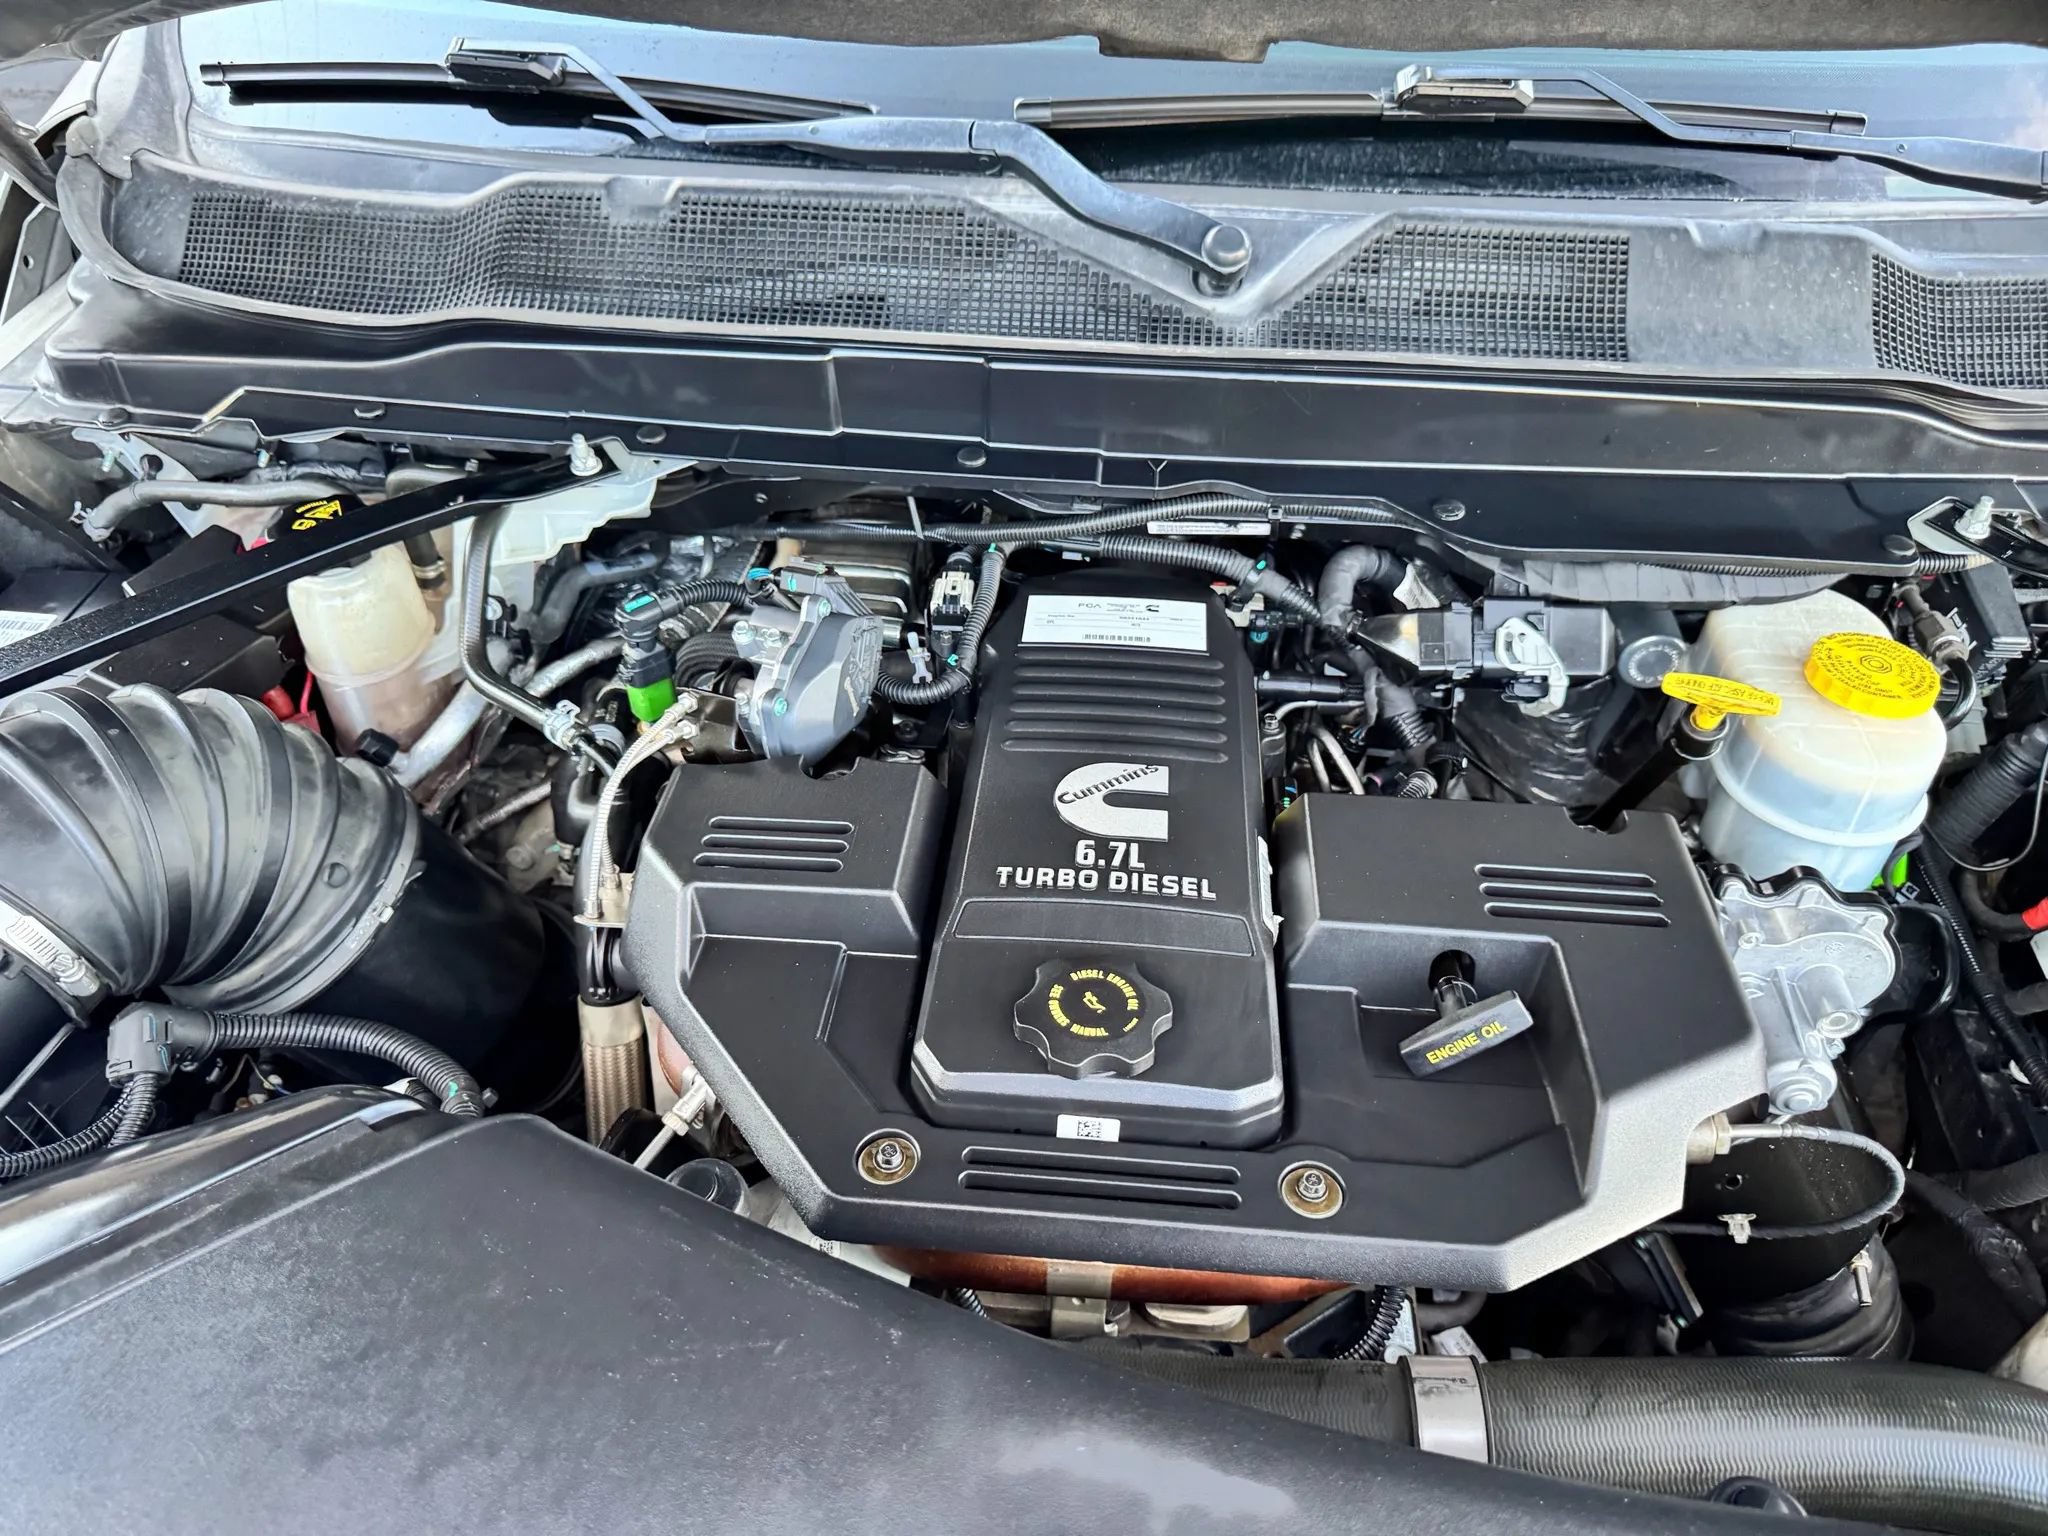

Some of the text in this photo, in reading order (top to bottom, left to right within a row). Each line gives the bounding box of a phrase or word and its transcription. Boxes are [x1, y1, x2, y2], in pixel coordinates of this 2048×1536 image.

[1056, 763, 1160, 805] Cummins
[1074, 839, 1146, 871] 6.7L
[996, 866, 1218, 902] TURBO DIESEL
[1070, 968, 1105, 981] DIESEL
[1106, 972, 1137, 998] ENGINE
[1070, 1023, 1109, 1037] MANUAL
[1426, 1021, 1507, 1064] ENGINE OIL
